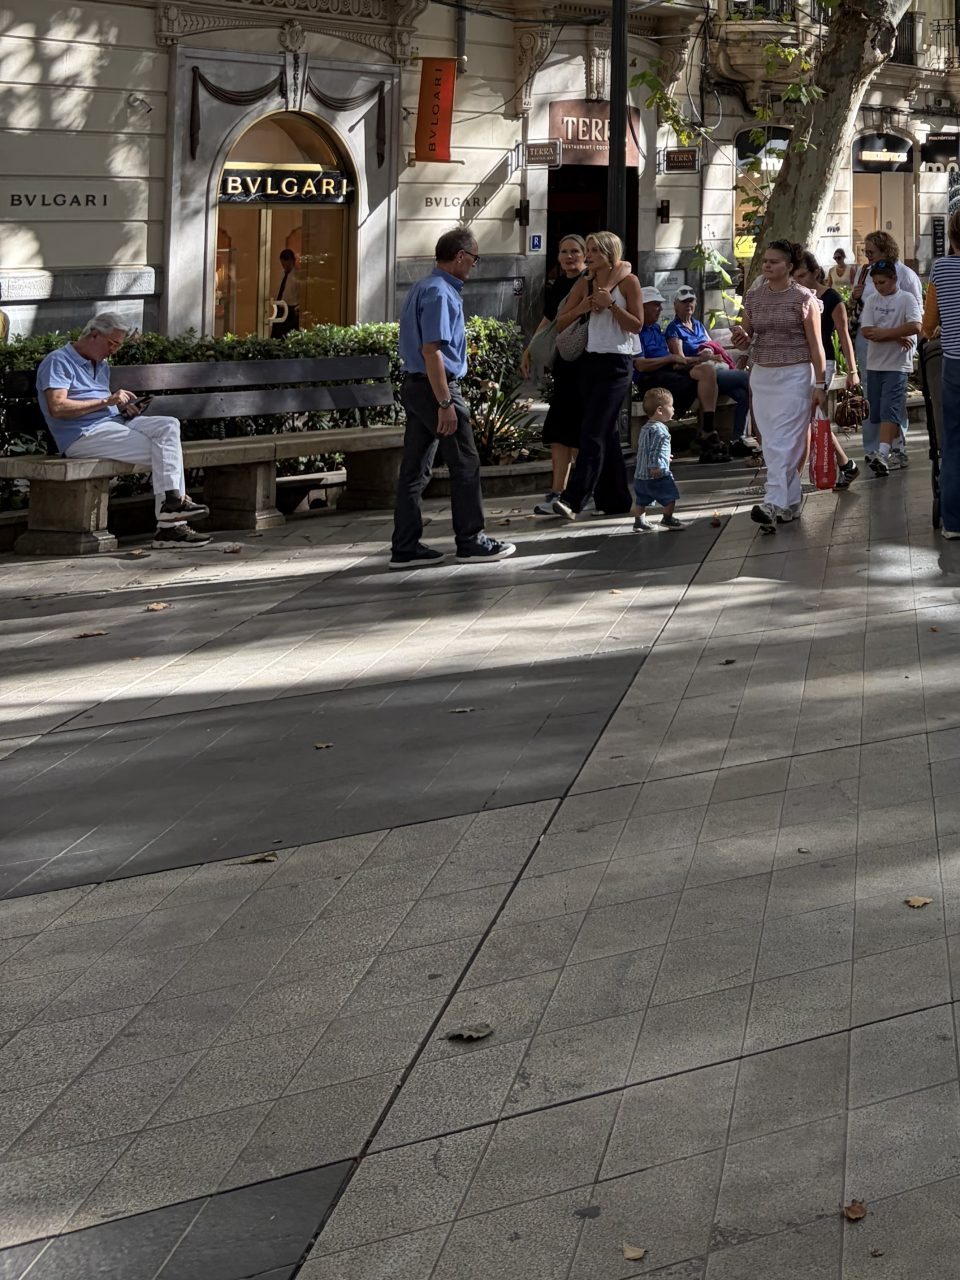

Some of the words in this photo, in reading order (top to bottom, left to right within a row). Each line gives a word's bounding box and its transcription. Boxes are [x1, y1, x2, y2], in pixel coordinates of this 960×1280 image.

[428, 68, 443, 152] BVLGARI
[562, 116, 610, 142] TER
[529, 147, 554, 156] TERRA
[669, 153, 693, 162] TERRA
[226, 176, 348, 195] BVLGARI
[10, 193, 109, 207] BVLGARI
[424, 196, 488, 208] BVLGARI
